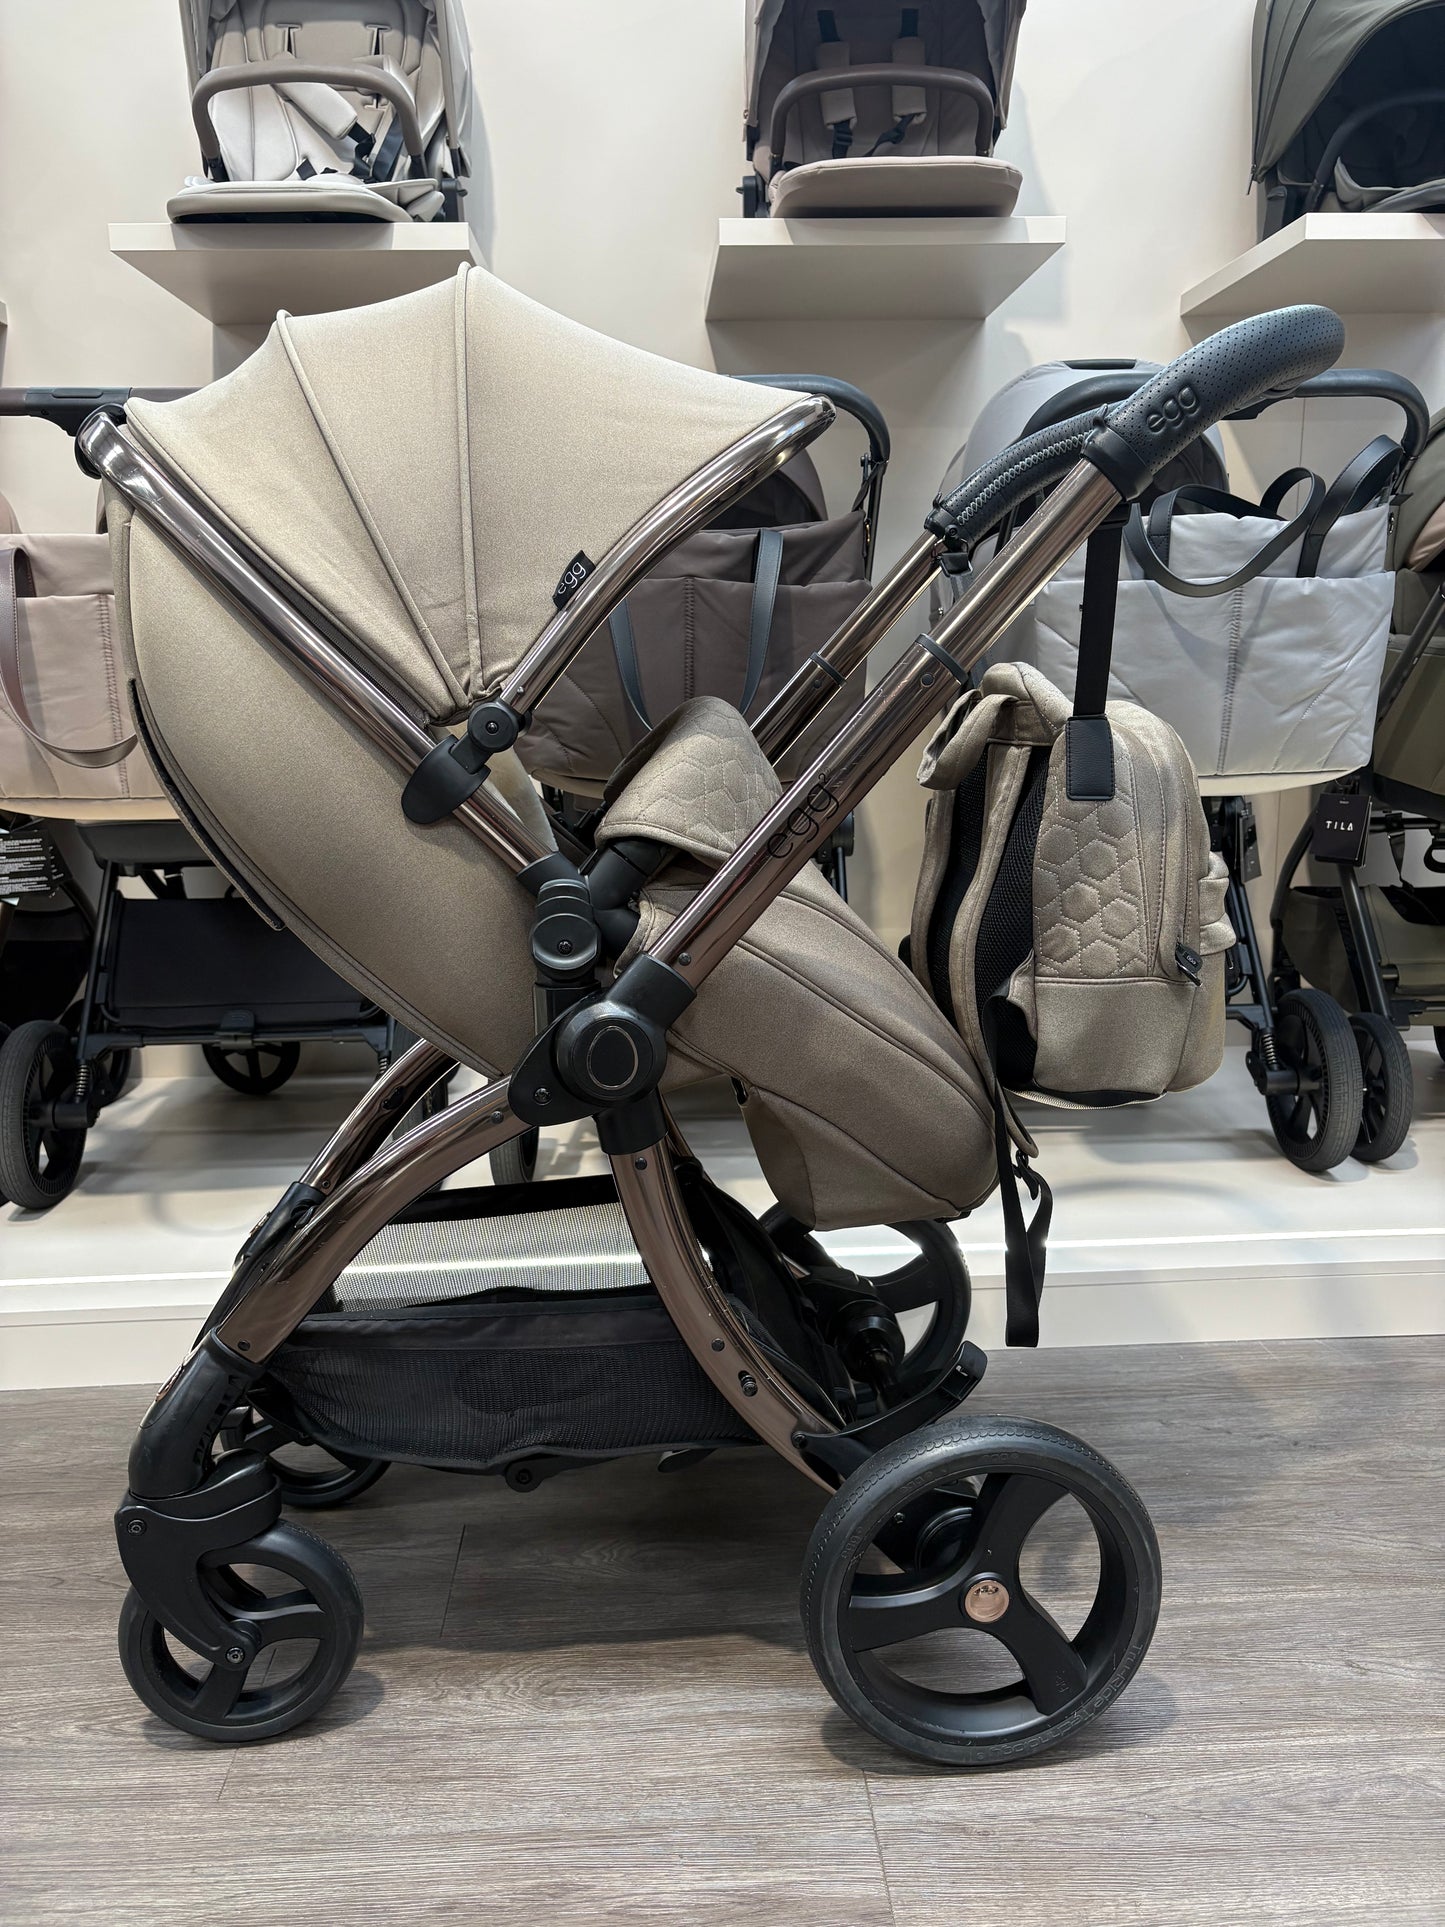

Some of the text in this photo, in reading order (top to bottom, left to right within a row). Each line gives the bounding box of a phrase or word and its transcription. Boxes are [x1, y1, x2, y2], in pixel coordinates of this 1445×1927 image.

[1146, 386, 1201, 435] egg
[557, 561, 587, 594] egg
[1325, 820, 1354, 831] TILA
